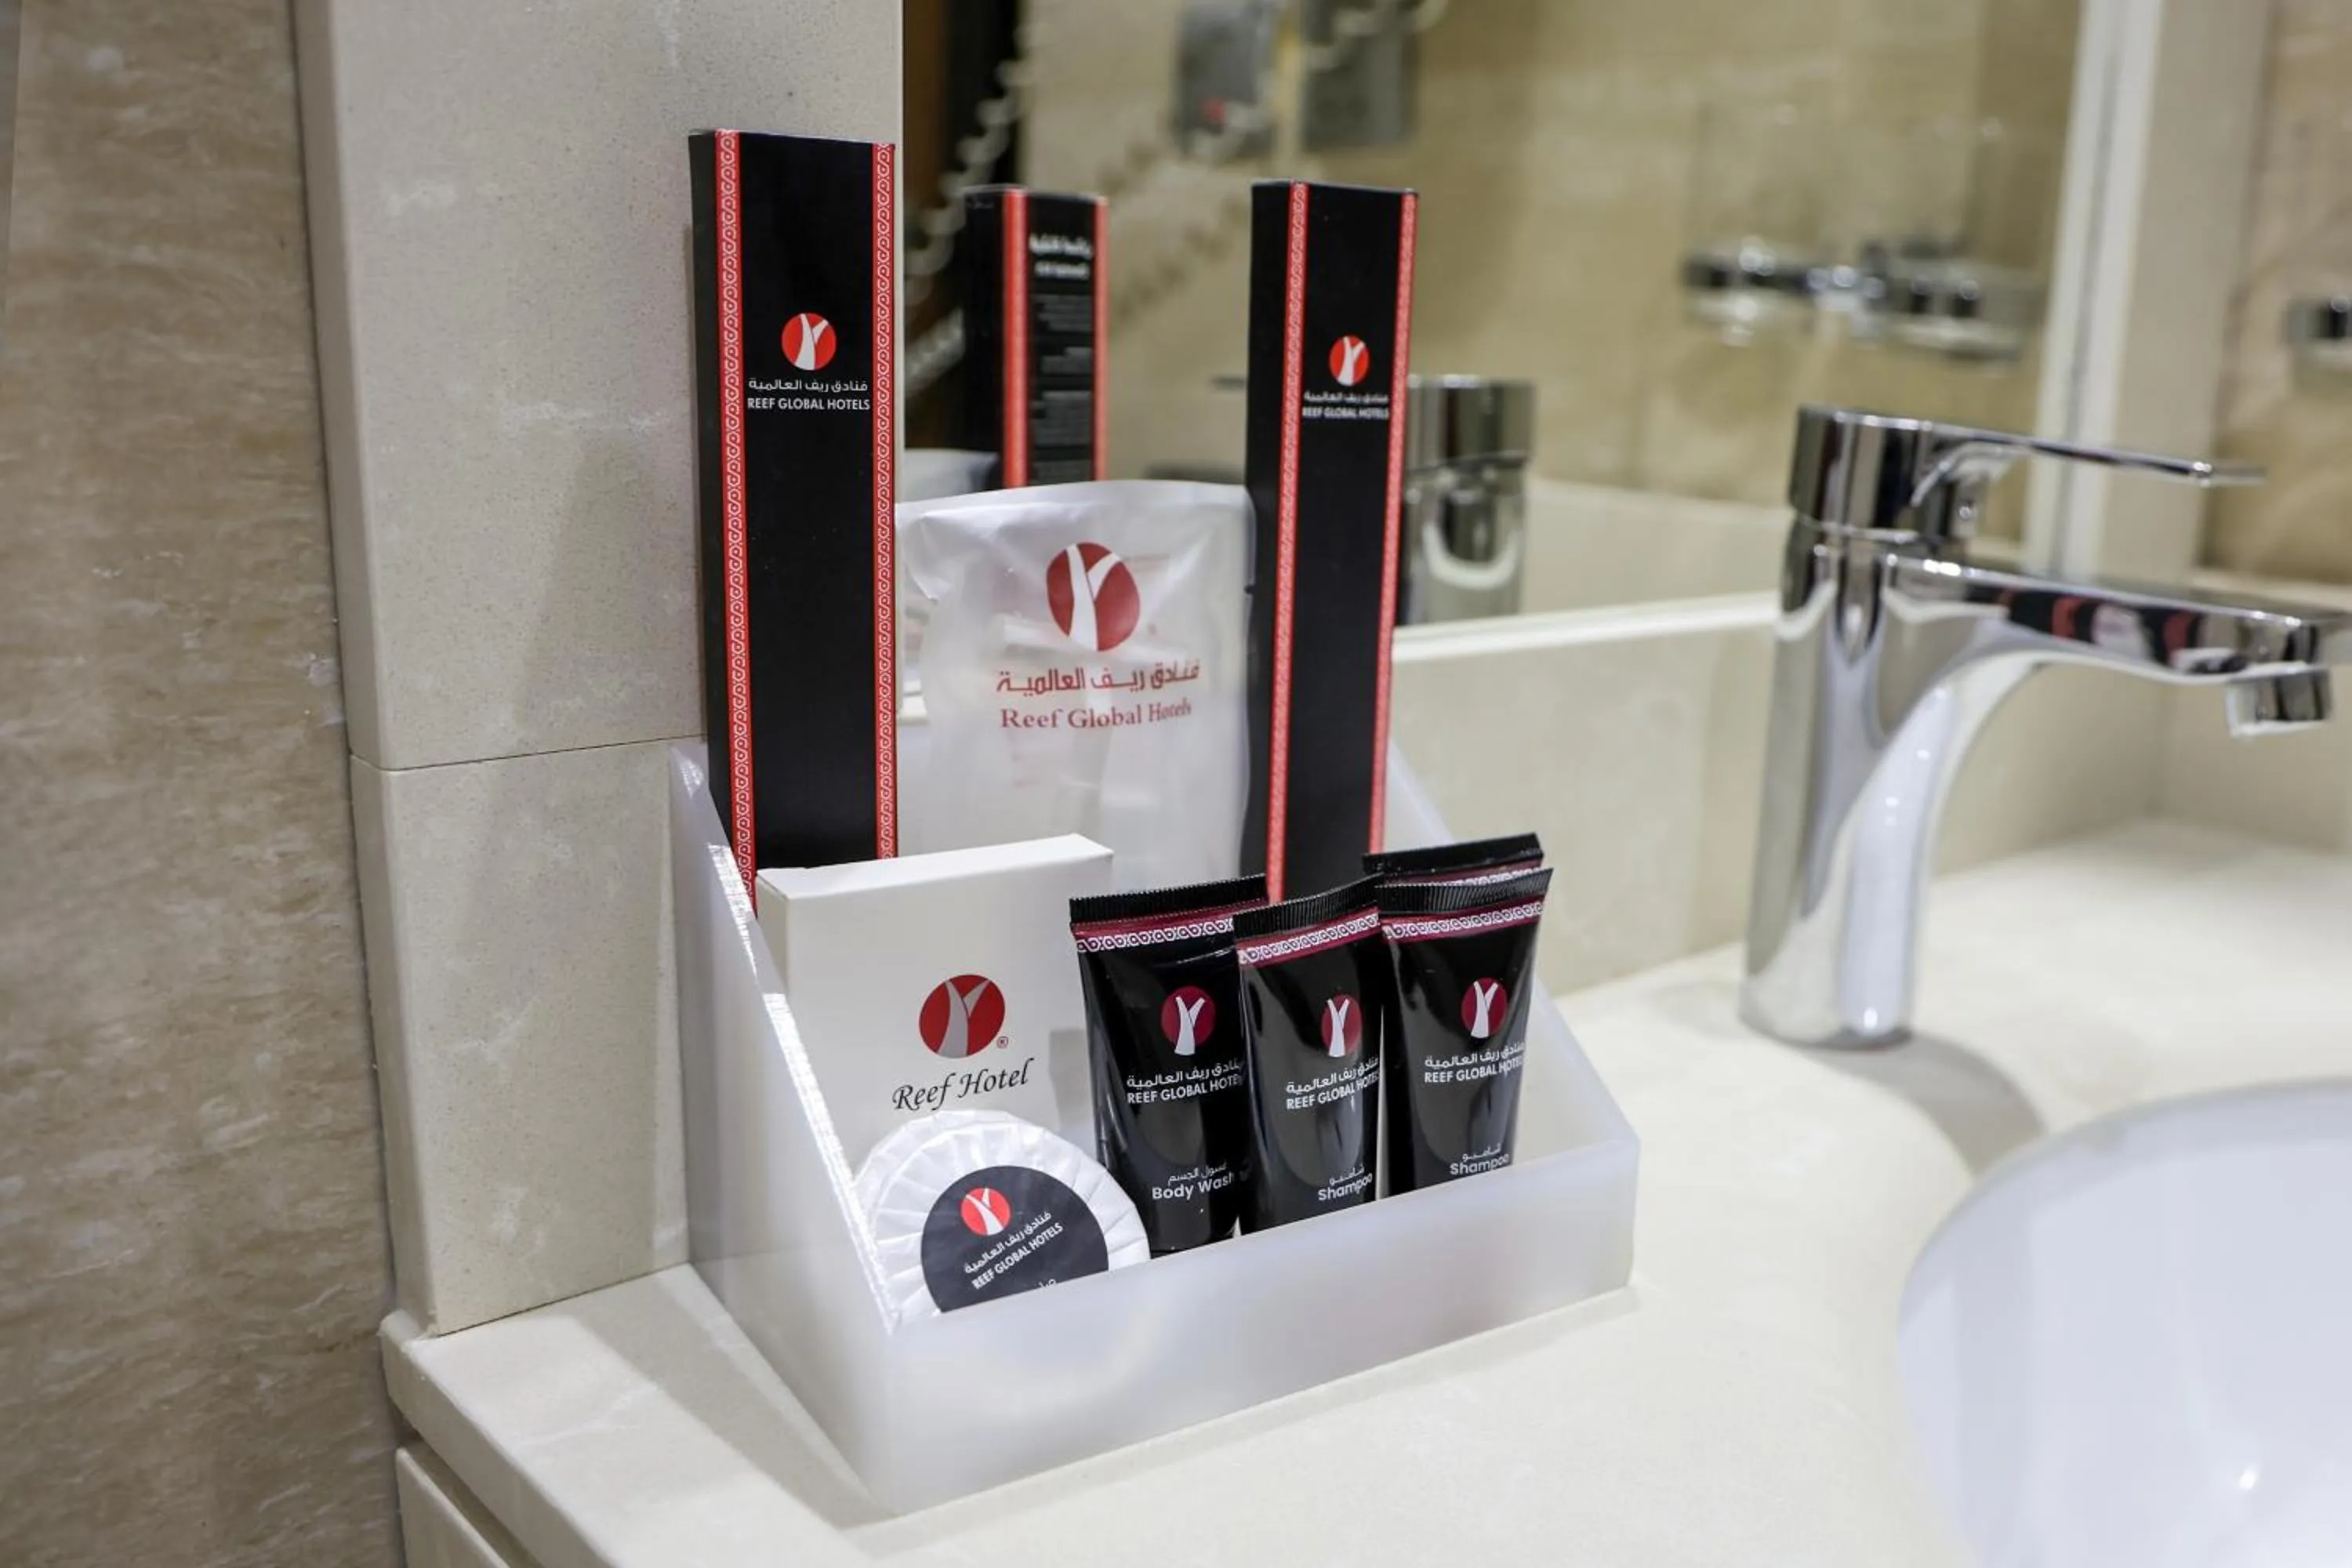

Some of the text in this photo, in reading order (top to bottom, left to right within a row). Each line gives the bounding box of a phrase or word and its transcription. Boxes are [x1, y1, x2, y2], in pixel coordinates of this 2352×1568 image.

[749, 378, 868, 392] فنادق ريف العالمية
[747, 397, 870, 410] REEF GLOBAL HOTELS
[1302, 407, 1389, 419] REEF GLOBAL HOTELS
[996, 659, 1200, 696] فنادق ريف العالمية
[1000, 697, 1192, 728] Reef Global Hotels
[1425, 1053, 1477, 1069] العالمية
[1479, 1048, 1499, 1062] ريف
[1127, 1070, 1183, 1090] العالمية
[1185, 1066, 1210, 1080] ريف
[1339, 1067, 1356, 1081] ريف
[1425, 1071, 1454, 1083] REEF
[1456, 1064, 1497, 1081] GLOBAL
[892, 1058, 1034, 1111] Reef Hotel
[1127, 1073, 1242, 1104] REEF GLOBAL HOTE
[1286, 1073, 1337, 1094] العالمية
[1287, 1095, 1316, 1110] REEF
[1317, 1081, 1356, 1104] GLOBAL
[1450, 1153, 1510, 1175] Shampoo
[1152, 1171, 1234, 1201] Body Wash
[1318, 1173, 1373, 1201] Shampoo
[1004, 1229, 1025, 1247] ريف
[971, 1222, 1064, 1290] REEF GLOBAL HOTELS
